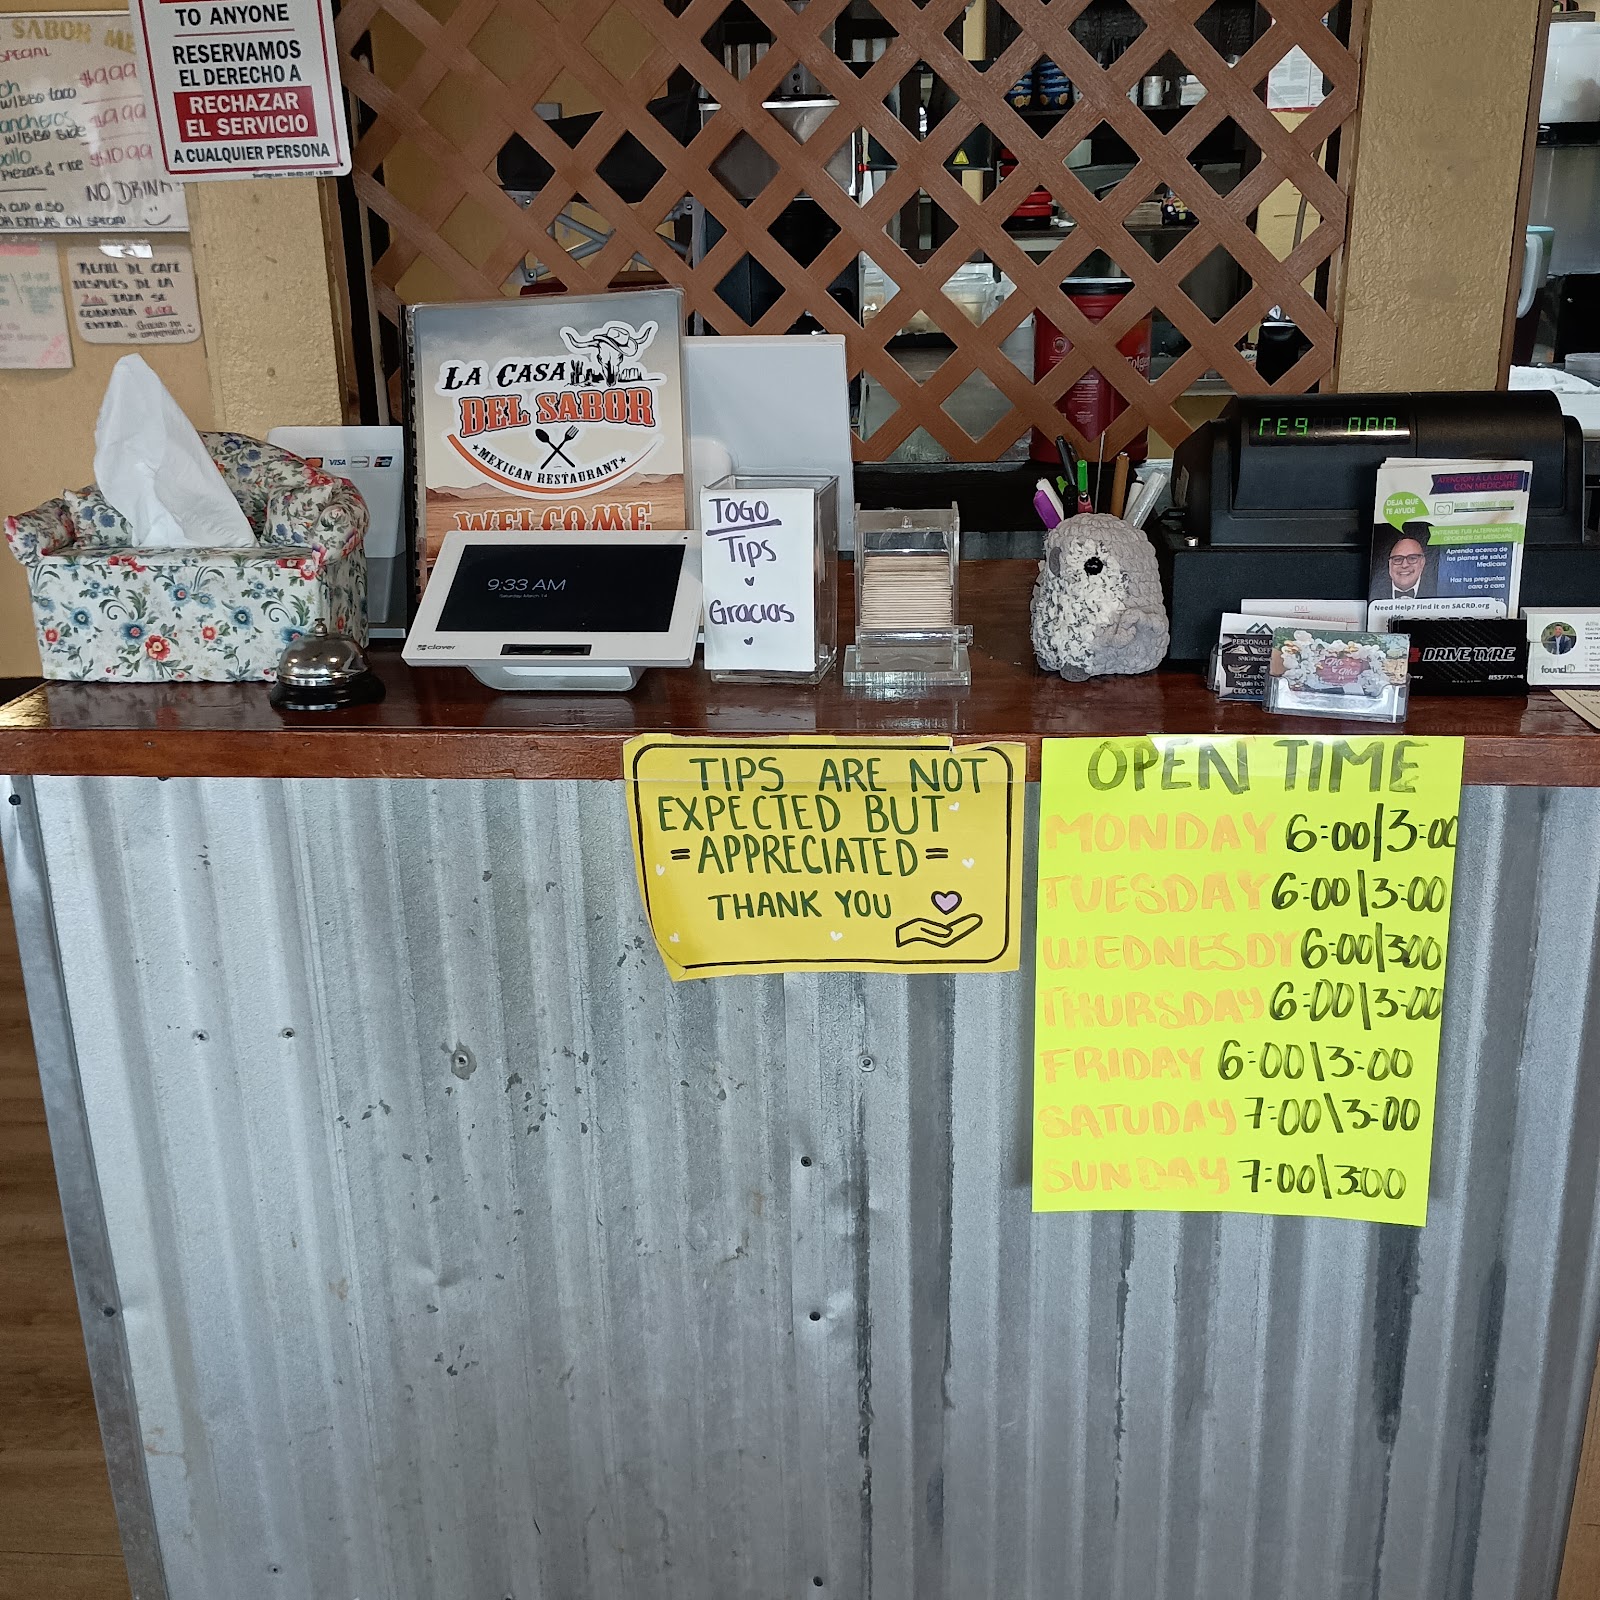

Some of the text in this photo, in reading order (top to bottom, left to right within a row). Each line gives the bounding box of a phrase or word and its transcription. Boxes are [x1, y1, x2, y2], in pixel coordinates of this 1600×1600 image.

[175, 3, 290, 26] TO ANYONE
[172, 40, 301, 64] RESERVAMOS
[179, 64, 301, 86] EL DERECHO A
[189, 92, 300, 115] RECHAZAR
[185, 114, 309, 137] EL SERVICIO
[174, 143, 330, 163] A CUALQUIER PERSONA
[86, 181, 111, 201] NO
[126, 263, 143, 275] DE
[135, 279, 151, 289] DE
[158, 278, 174, 289] LA
[442, 361, 566, 390] LA CASA
[459, 387, 656, 438] DEL SABOR
[477, 447, 621, 485] MEXICAN RESTAURANT
[1453, 480, 1517, 491] CON MEDICARE
[1386, 498, 1419, 507] DEJA QUE
[1386, 506, 1416, 515] TE AYUDE
[453, 501, 652, 530] WELCOME
[718, 535, 777, 568] Tips
[1446, 548, 1474, 556] Aprenda
[1456, 555, 1479, 563] planes
[1476, 560, 1507, 568] Medicare
[488, 578, 567, 591] 9:33 AM
[1450, 576, 1462, 584] Haz
[1473, 576, 1506, 584] preguntas
[709, 599, 795, 625] Gracias
[1395, 603, 1416, 612] Help?
[1416, 603, 1432, 611] Find
[1451, 601, 1490, 611] SACRD.org
[1232, 638, 1268, 646] PERSONAL
[1422, 647, 1516, 662] DRIVE TYRE
[689, 757, 987, 794] TIPS ARE NOT
[1087, 740, 1428, 794] OPEN TIME
[658, 795, 945, 835] EXPECTED BUT
[1045, 812, 1276, 853] MONDAY
[1041, 871, 1273, 914] TUESDAY
[707, 890, 892, 920] THANK YOU
[1042, 930, 1300, 971] WEDNESDY
[1040, 986, 1266, 1030] THURSDAY
[1040, 1045, 1206, 1084] FRIDAY
[1039, 1098, 1238, 1139] SATUDAY
[1041, 1156, 1231, 1195] SUNDAY
